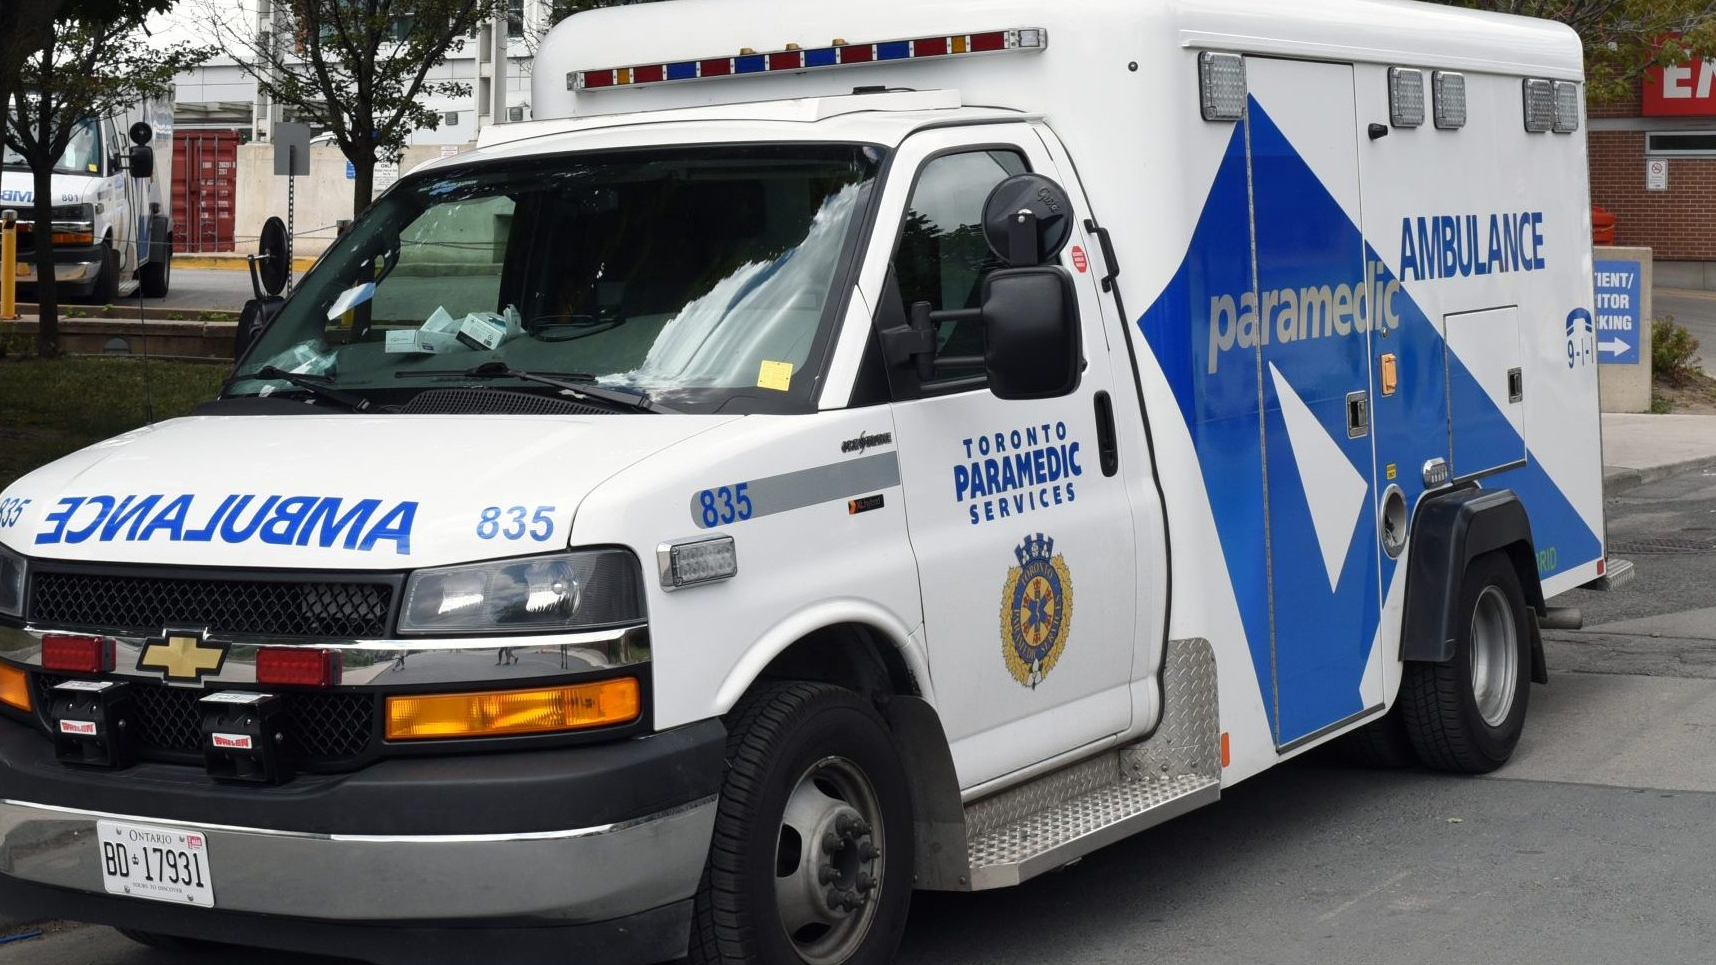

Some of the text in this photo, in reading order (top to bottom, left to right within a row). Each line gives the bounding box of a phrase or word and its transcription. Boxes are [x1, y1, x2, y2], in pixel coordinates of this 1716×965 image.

[61, 194, 79, 202] 801
[1400, 211, 1545, 282] AMBULANCE
[1208, 260, 1400, 374] paramedic
[1596, 293, 1629, 309] ITOR
[963, 421, 1066, 459] TORONTO
[953, 441, 1082, 502] PARAMEDIC
[476, 505, 556, 542] 835
[700, 482, 752, 528] 835
[969, 482, 1075, 525] SERVICES
[129, 829, 172, 845] ONTARIO
[104, 841, 204, 888] BD 17931
